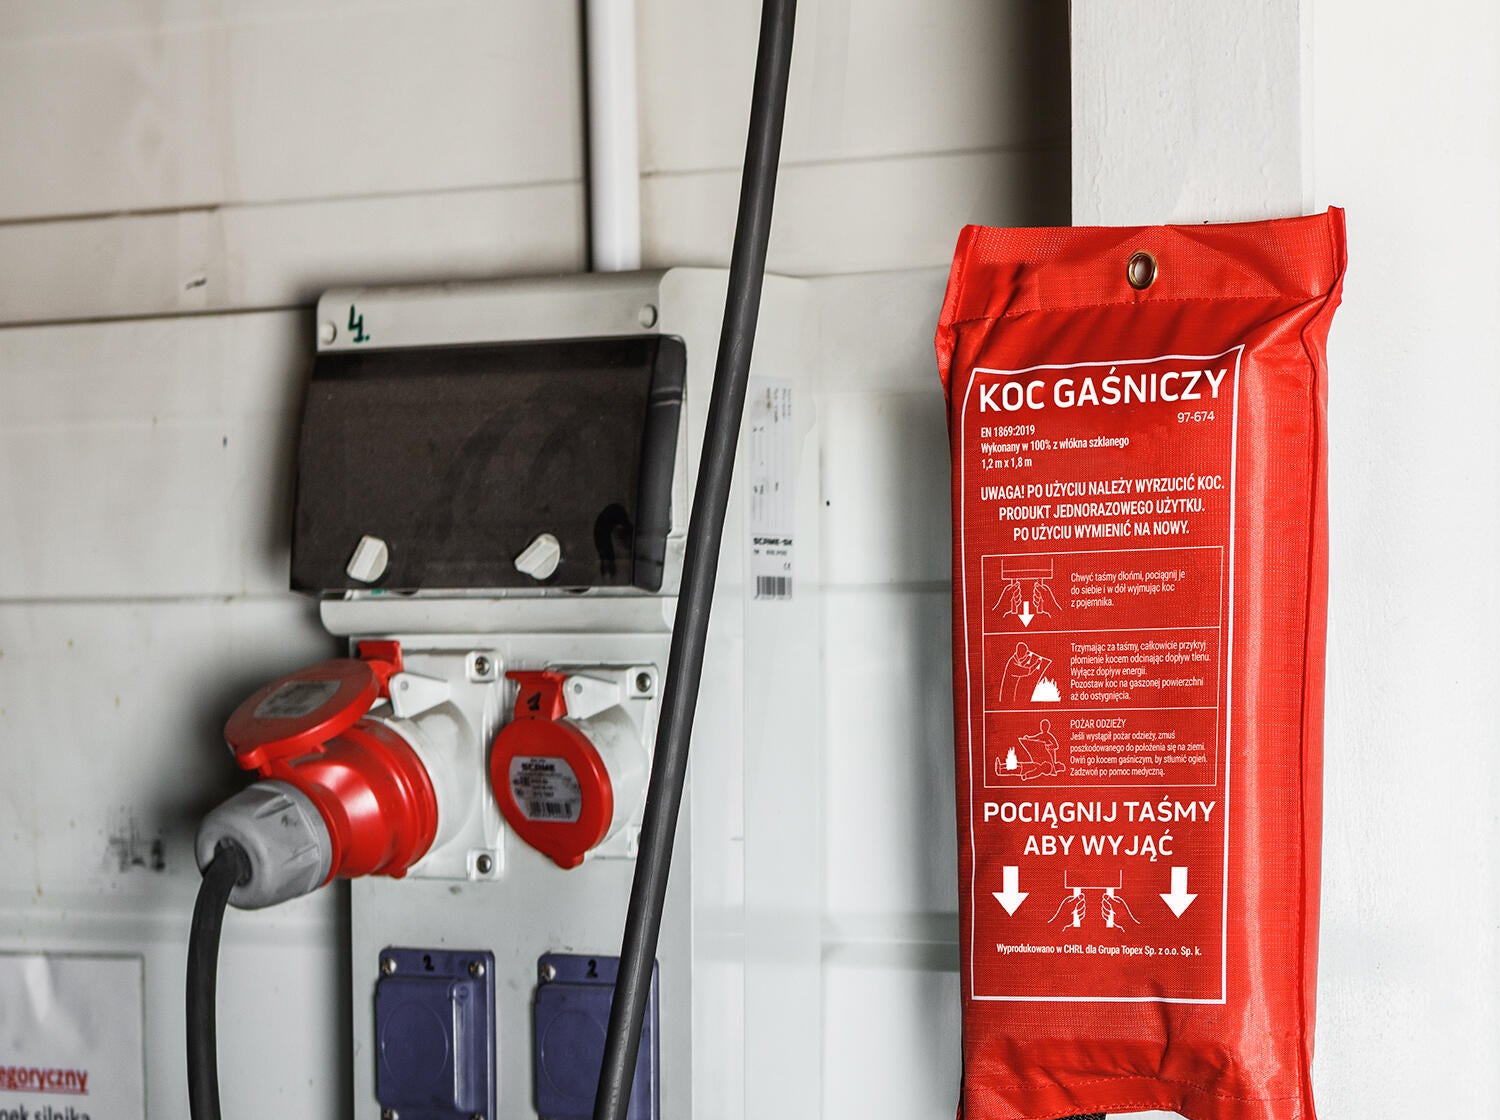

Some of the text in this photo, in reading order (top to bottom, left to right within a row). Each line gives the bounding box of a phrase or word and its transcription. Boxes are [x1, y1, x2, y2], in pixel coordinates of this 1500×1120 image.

[979, 366, 1227, 412] KOC GAŚNICZY
[1177, 411, 1215, 422] 97-674
[981, 425, 1035, 437] EN 1869:2019
[981, 436, 1129, 455] Wykonany w 100% z włókna szklanego
[981, 459, 994, 470] 1,2
[995, 460, 1002, 468] m
[1010, 458, 1023, 469] 1,8
[1024, 458, 1032, 467] m
[981, 474, 1225, 500] UWAGA! PO UŻYCIU NALEŻY WYRZUCIĆ KOC.
[999, 498, 1205, 521] PRODUKT JEDNORAZOWEGO UŻYTKU.
[1014, 520, 1189, 541] PO UŻYCIU WYMIENIĆ NA NOWY.
[1070, 570, 1185, 584] Chwyć taśmy dłońmi, pociągnij je
[1070, 585, 1080, 595] do
[1082, 584, 1102, 594] siebie
[1114, 583, 1126, 593] dół
[1128, 583, 1160, 595] wyjmując
[1162, 582, 1175, 591] koc
[1076, 597, 1114, 609] pojemnika.
[1070, 642, 1105, 654] Trzymając
[1117, 642, 1140, 653] taśmy,
[1140, 640, 1178, 651] całkowicie
[1179, 640, 1206, 651] przykryj
[1070, 652, 1210, 666] płomienie kocem odcinając dopływ tlenu.
[1070, 666, 1147, 679] Wyłącz dopływ energii.
[1070, 679, 1104, 688] Pozostaw
[1105, 678, 1118, 688] koc
[1129, 678, 1160, 690] gaszonej
[1162, 677, 1204, 688] powierzchni
[1071, 691, 1131, 703] aż do ostygnięcia.
[1070, 718, 1126, 728] POŻAR ODZIEŻY
[984, 795, 1216, 829] POCIĄGNIJ TAŚMY
[1024, 829, 1173, 862] ABY WYJĄĆ
[996, 943, 1054, 955] Wyprodukowano
[1064, 944, 1084, 954] CHRL
[1085, 944, 1096, 954] dla
[1098, 945, 1120, 956] Grupa
[1121, 946, 1142, 956] Topex
[1144, 946, 1156, 956] Sp.
[1181, 946, 1193, 957] Sp.
[1195, 946, 1201, 955] k.
